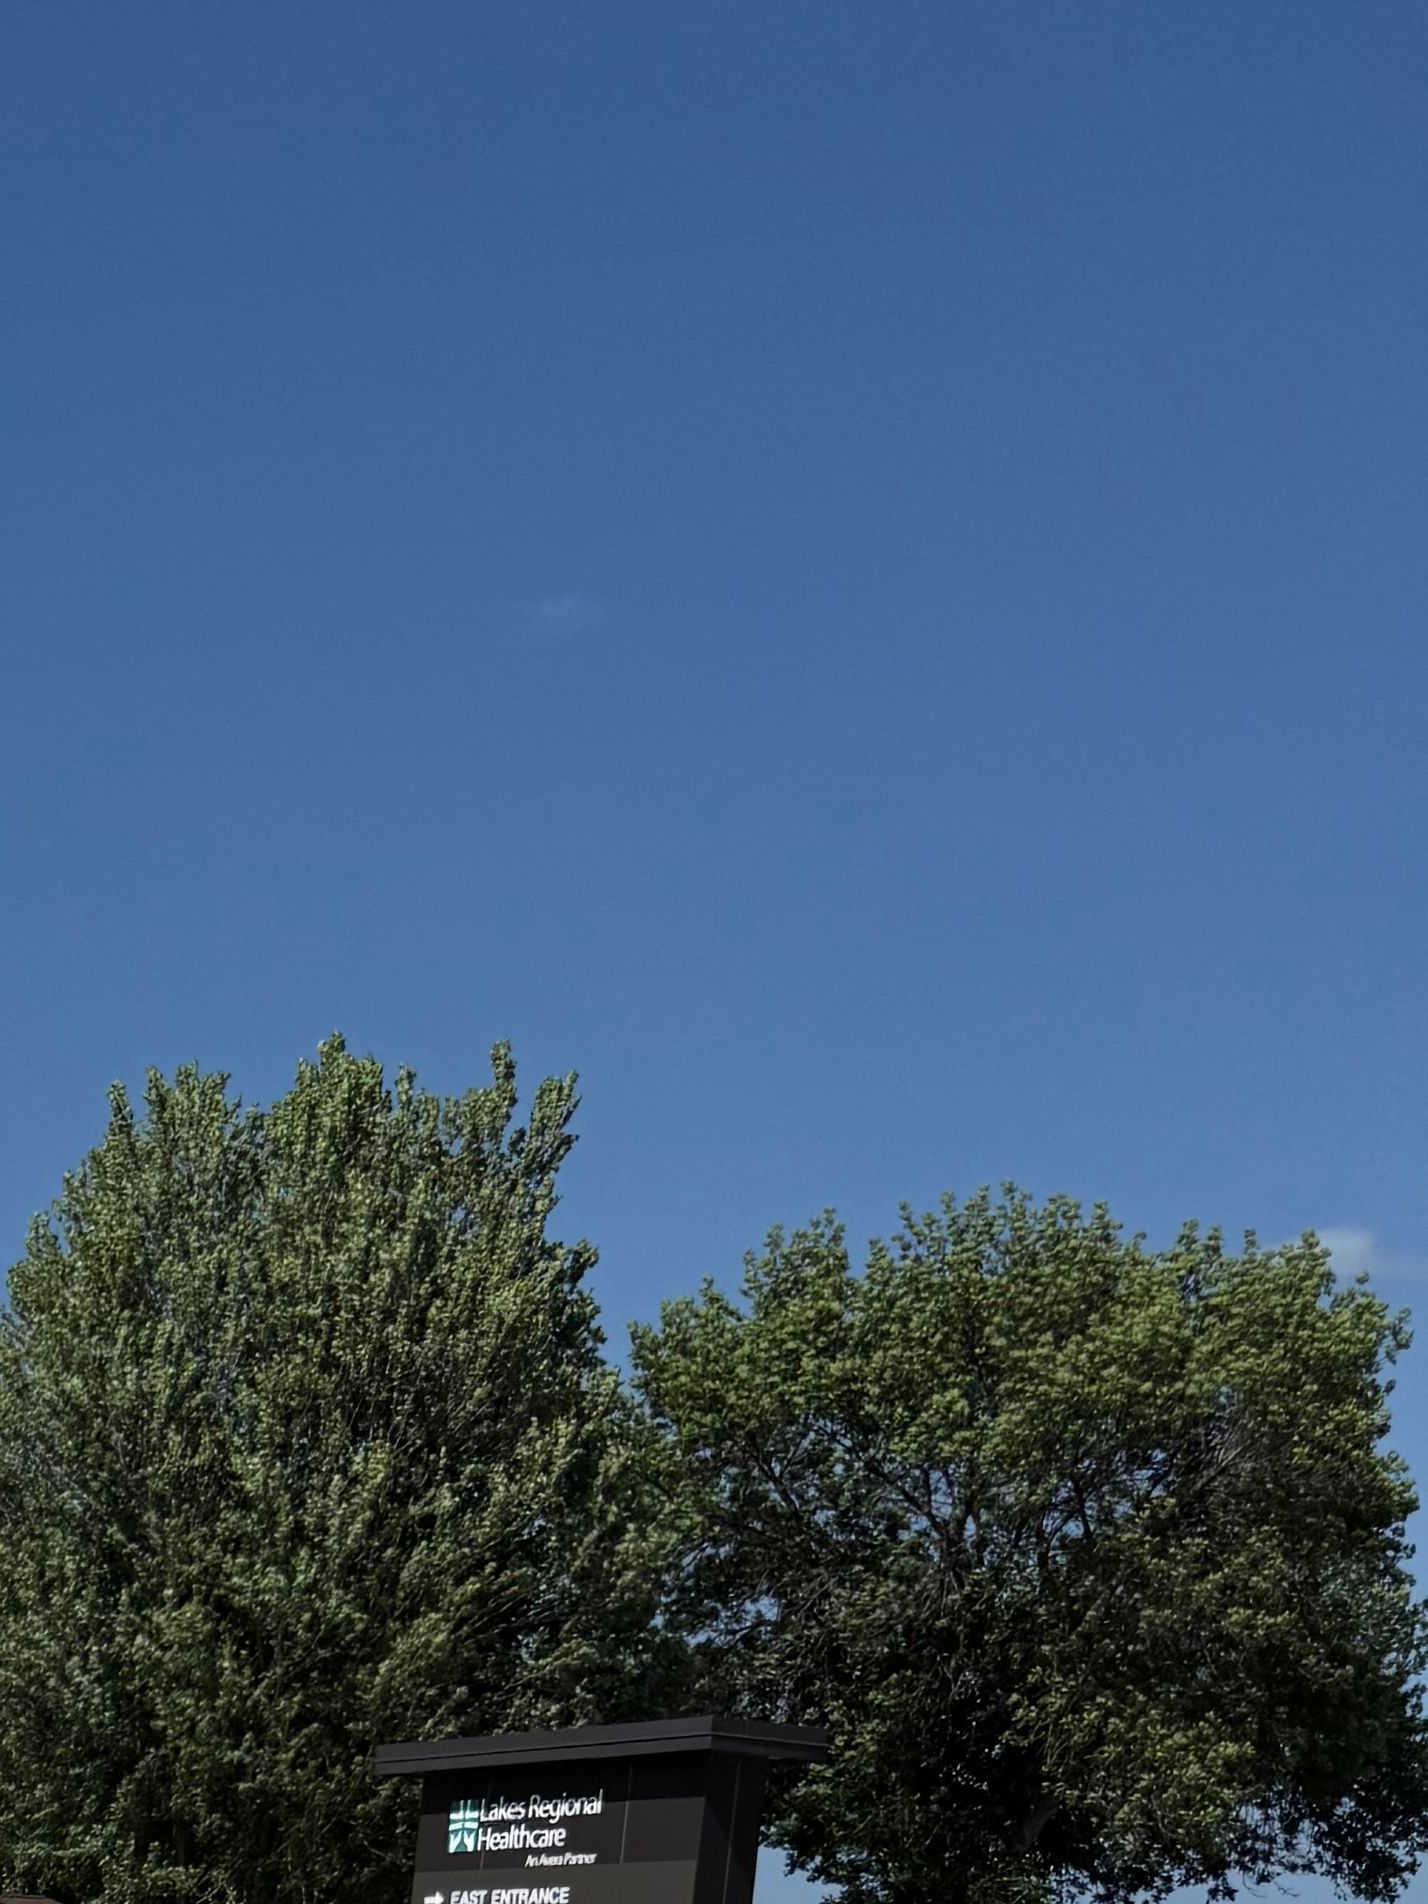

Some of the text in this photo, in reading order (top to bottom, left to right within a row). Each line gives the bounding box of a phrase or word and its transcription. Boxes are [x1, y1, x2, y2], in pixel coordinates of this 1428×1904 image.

[480, 1788, 603, 1824] Lakes Regional
[477, 1823, 566, 1851] Healthcare
[524, 1854, 539, 1867] An
